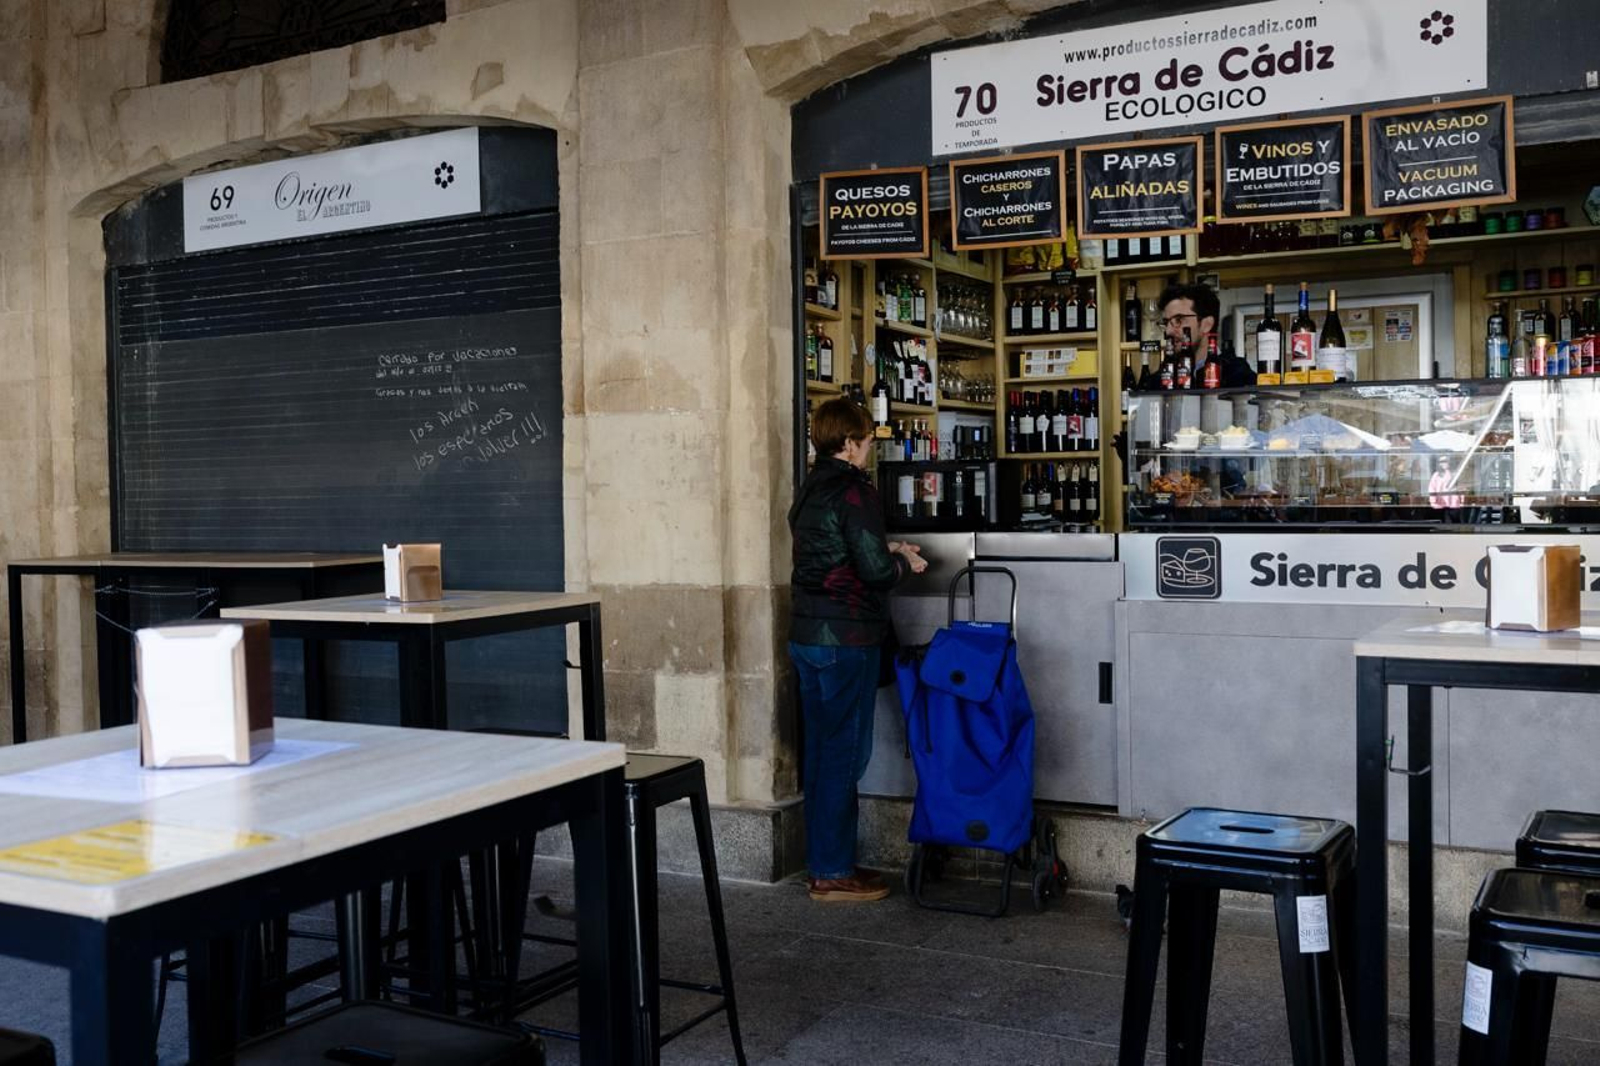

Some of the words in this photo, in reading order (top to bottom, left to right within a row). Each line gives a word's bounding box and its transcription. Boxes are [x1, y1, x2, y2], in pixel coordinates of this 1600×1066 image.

[1064, 15, 1317, 63] www.productossierradecadiz.com
[1036, 72, 1140, 107] Sierra
[1154, 58, 1203, 91] de
[1218, 40, 1335, 82] Cádiz
[954, 82, 997, 118] 70
[1105, 86, 1266, 121] ECOLOGICO
[955, 117, 997, 129] PRODUCTOS
[1385, 114, 1488, 137] ENVASADO
[954, 137, 998, 150] TEMPORADA
[1251, 142, 1313, 159] VINOS
[1316, 140, 1330, 154] Y
[1394, 139, 1419, 153] AL
[1422, 130, 1480, 149] VACÍO
[1226, 161, 1341, 183] EMBUTIDOS
[1398, 164, 1478, 183] VACUUM
[210, 185, 234, 211] 69
[274, 171, 352, 221] Origen
[835, 185, 911, 201] QUESOS
[980, 180, 1033, 194] CASEROS
[1002, 193, 1010, 201] Y
[1090, 180, 1190, 199] ALIÑADAS
[1384, 179, 1494, 202] PACKAGING
[829, 201, 918, 219] PAYOYOS
[981, 218, 997, 228] AL
[997, 214, 1035, 226] CORTE
[1249, 551, 1382, 589] Sierra
[1397, 552, 1457, 590] de
